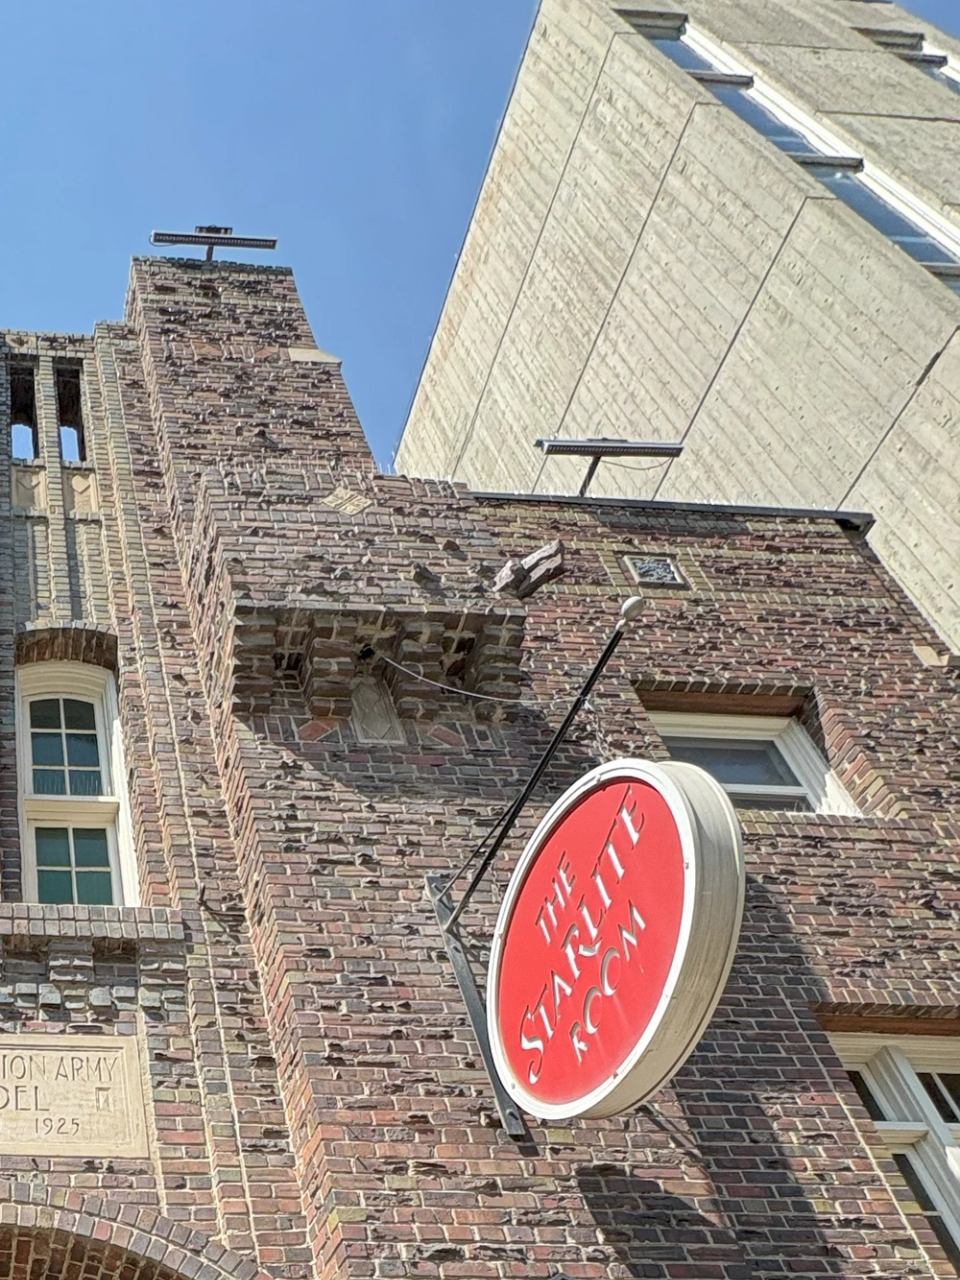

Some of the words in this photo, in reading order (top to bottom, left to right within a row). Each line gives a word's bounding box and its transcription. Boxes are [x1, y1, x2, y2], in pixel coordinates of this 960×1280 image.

[520, 784, 645, 1084] STARLITE
[535, 850, 576, 945] THE
[569, 899, 646, 1064] ROOM
[55, 1056, 118, 1082] ARMY
[35, 1117, 80, 1136] 1925
